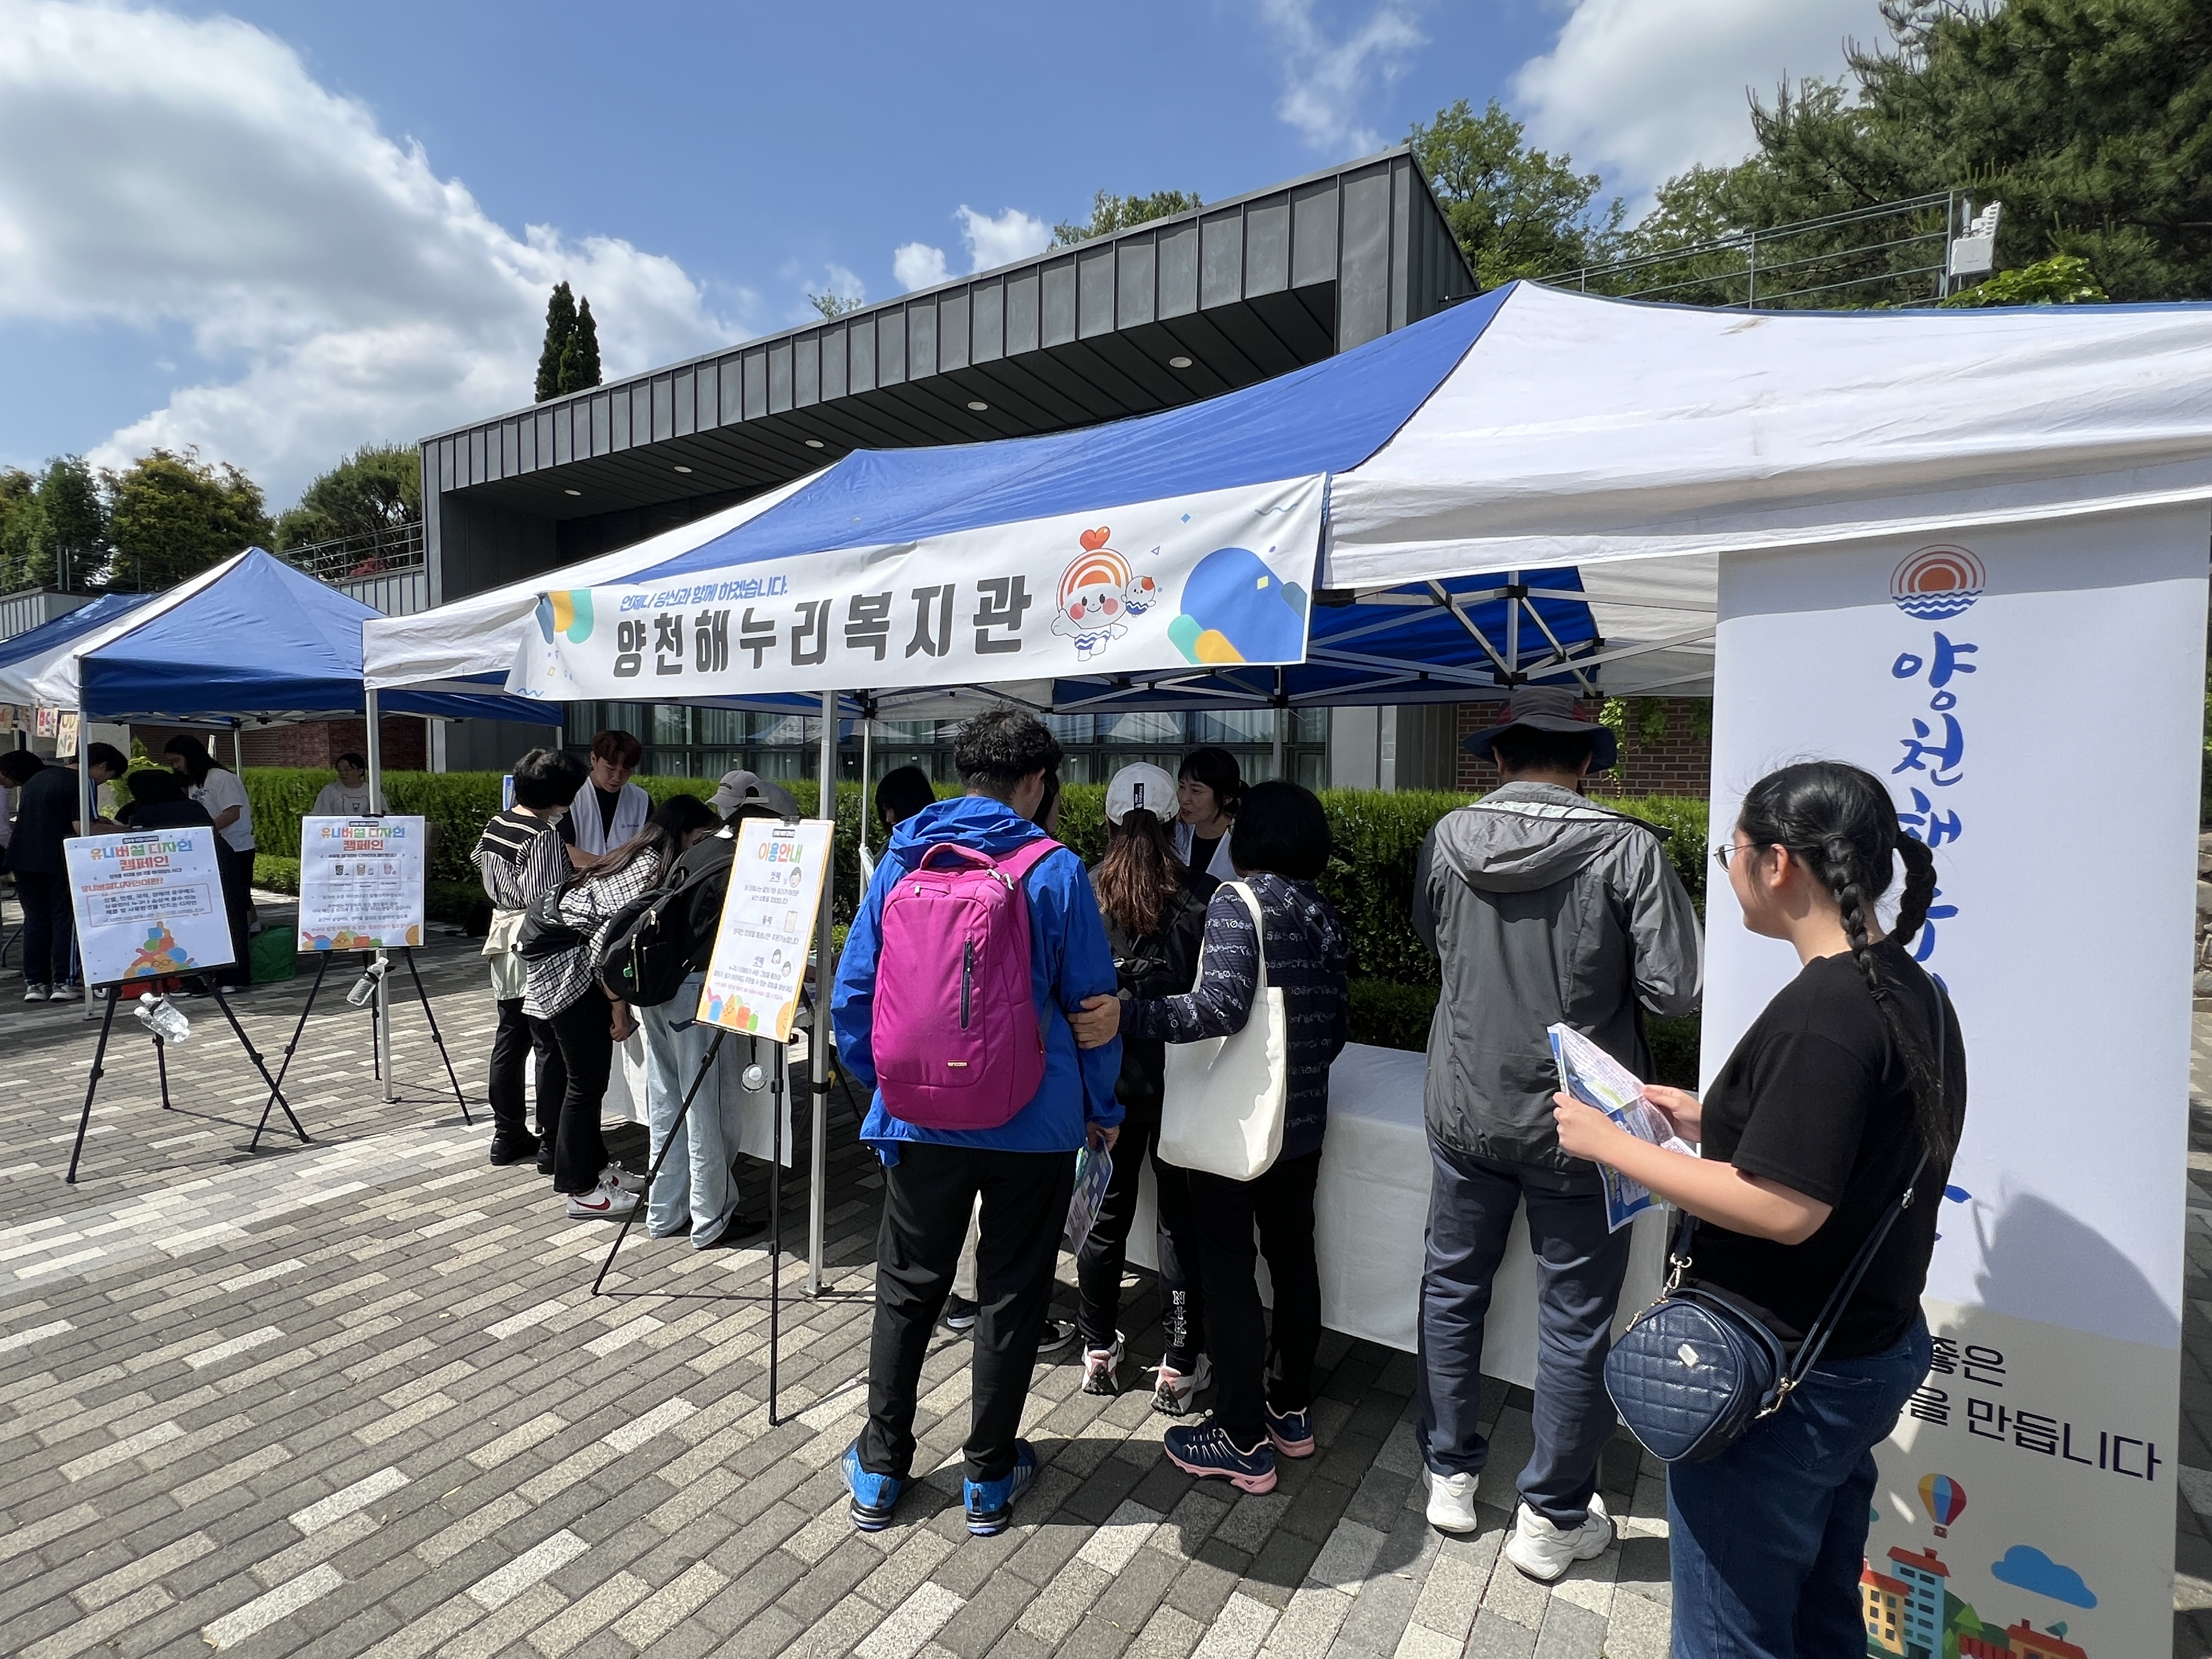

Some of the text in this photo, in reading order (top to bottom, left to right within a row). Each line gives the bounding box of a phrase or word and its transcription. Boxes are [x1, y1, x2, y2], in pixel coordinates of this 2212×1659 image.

[620, 575, 788, 612] 언제나 당신과 함께 하겠습니다.
[613, 575, 1032, 678] 양천해누리복지관
[321, 826, 405, 838] 유니버설 디자인
[91, 844, 145, 860] 유니버설
[148, 838, 193, 855] 디자인
[343, 839, 384, 851] 캠페인
[758, 842, 804, 864] 이용안내
[120, 855, 170, 871] 캠페인
[81, 878, 164, 893] 유니버설디자인이란?
[1900, 1385, 2163, 1481] 을 만듭니다
